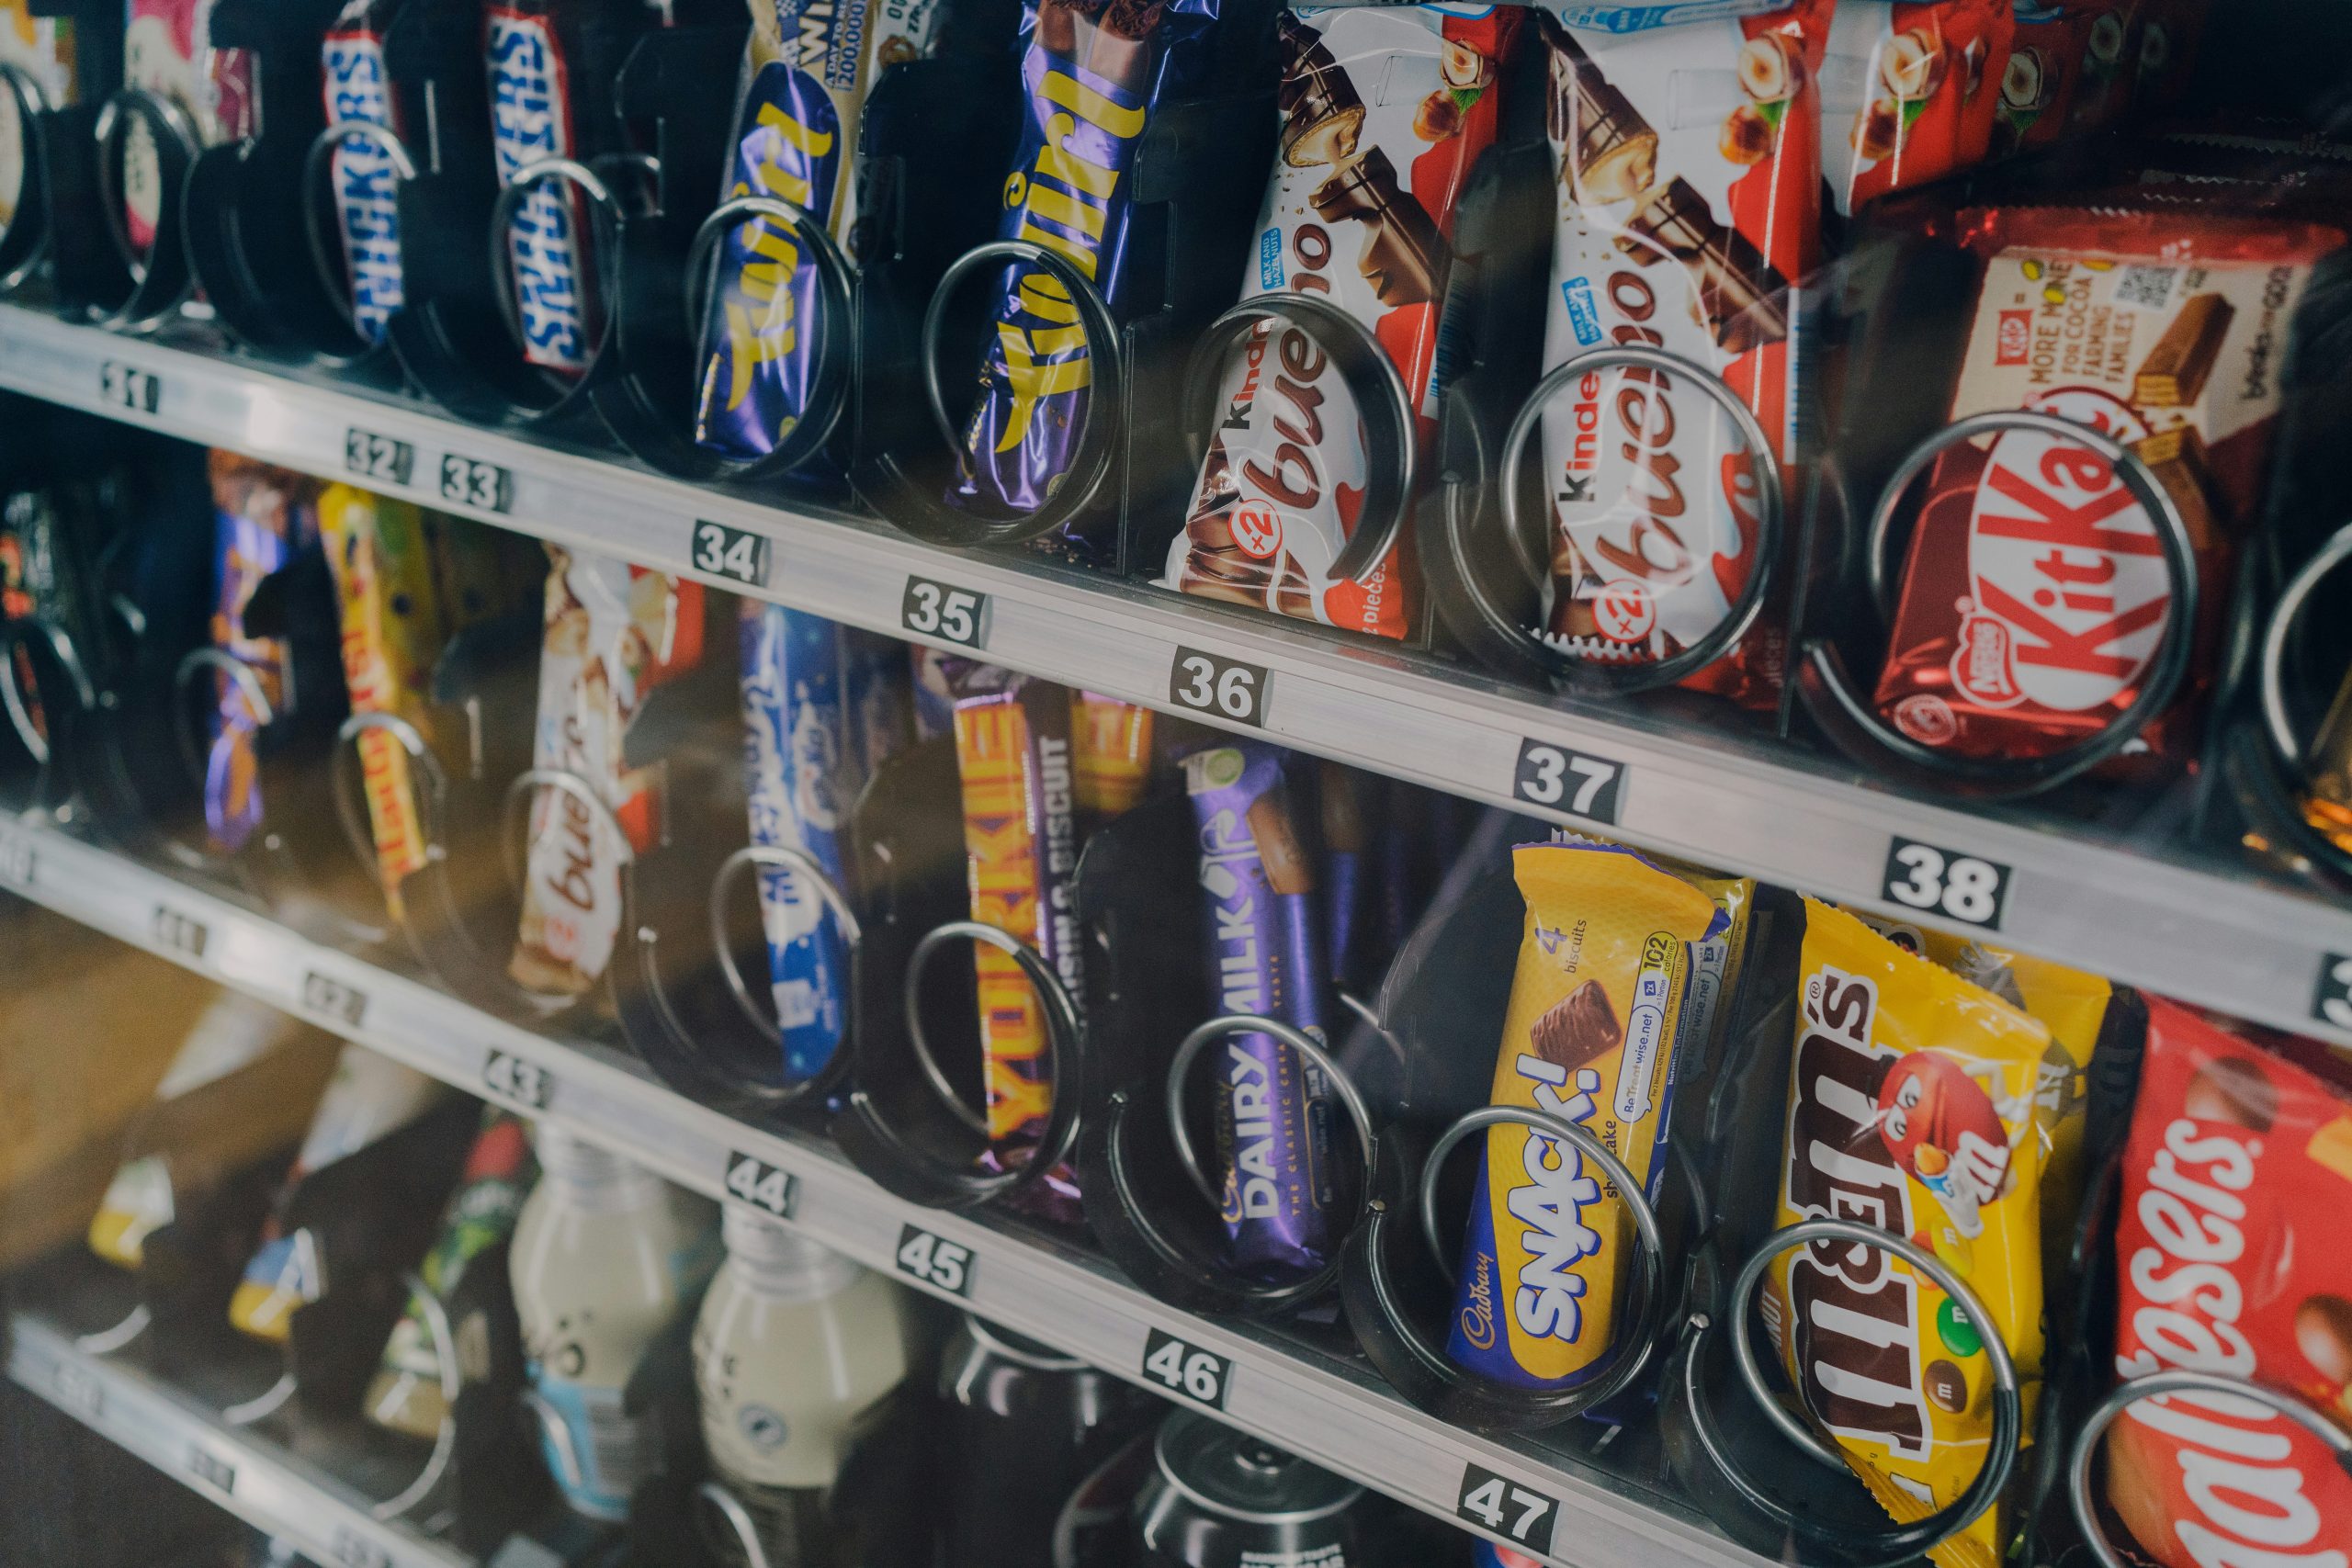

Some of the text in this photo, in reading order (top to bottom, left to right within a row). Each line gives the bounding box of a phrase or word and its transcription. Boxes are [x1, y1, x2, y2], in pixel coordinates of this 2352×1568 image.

[725, 102, 832, 411] Twirl
[997, 70, 1146, 453] Twirl
[1263, 260, 1272, 285] MILK
[2065, 277, 2093, 340] COCOA
[2029, 325, 2060, 384] MORE
[348, 431, 397, 479] 32
[445, 457, 498, 508] 33
[697, 525, 755, 583] 34
[909, 582, 977, 643] 35
[1178, 656, 1255, 718] 36
[1040, 736, 1074, 873] BISCUIT
[1521, 747, 1615, 814] 37
[1889, 842, 2001, 922] 38
[959, 708, 1058, 1141] YORKIE
[1535, 927, 1568, 954] 4
[1565, 919, 1588, 974] biscuits
[1644, 937, 1668, 969] 102
[1664, 941, 1677, 972] calories
[1216, 895, 1280, 1219] DAIRY MILK
[1668, 999, 1690, 1085] Nutrition Information
[488, 1050, 539, 1104] 43
[1282, 1098, 1298, 1173] CLASSIC
[727, 1155, 788, 1213] 44
[1289, 1183, 1301, 1217] THE
[1508, 1053, 1601, 1345] SNACK!
[899, 1231, 965, 1291] 45
[1461, 1251, 1496, 1350] Cadbury
[1146, 1341, 1218, 1401] 46
[1464, 1478, 1550, 1540] 47
